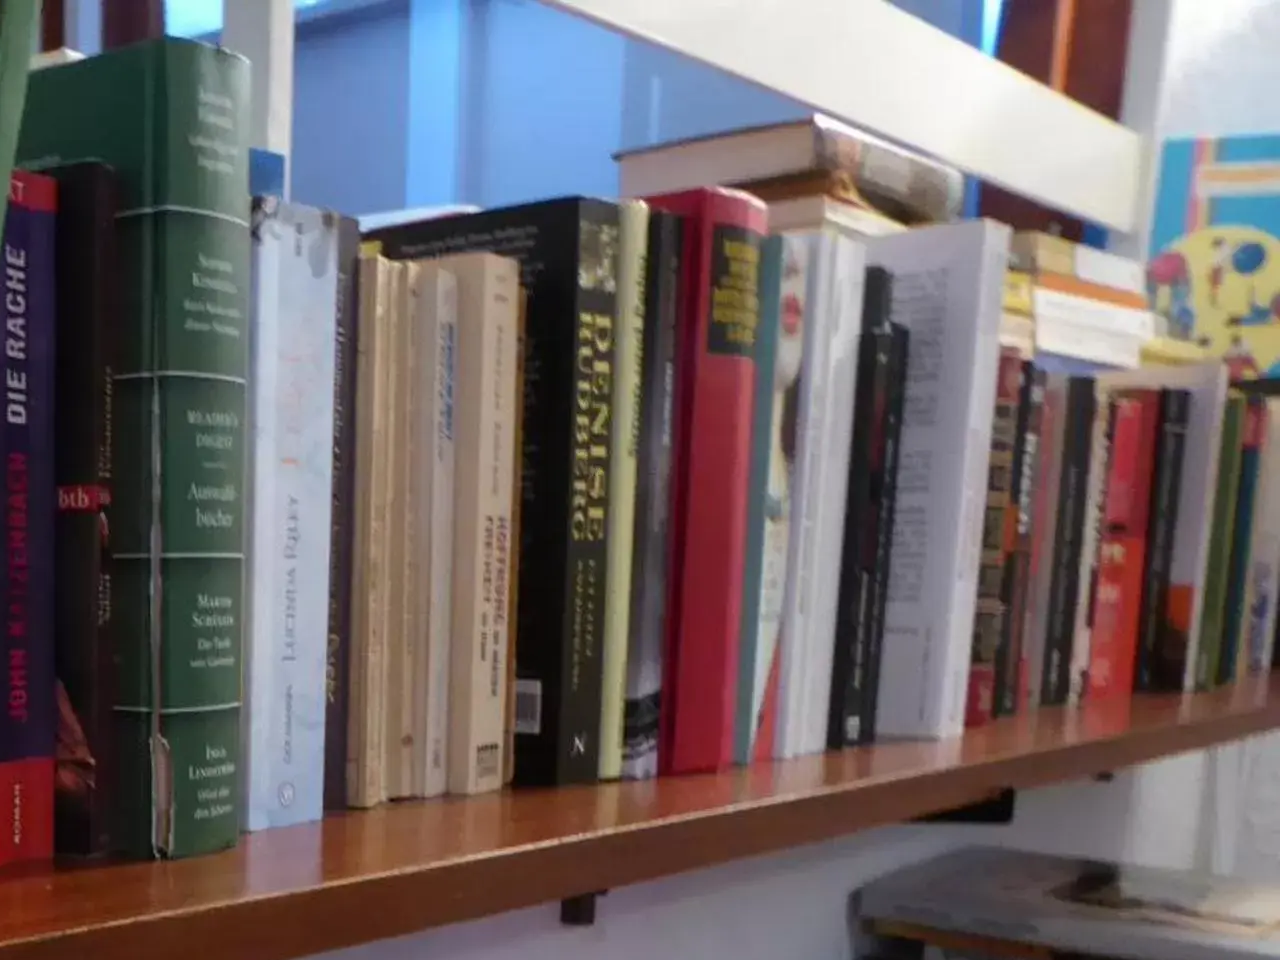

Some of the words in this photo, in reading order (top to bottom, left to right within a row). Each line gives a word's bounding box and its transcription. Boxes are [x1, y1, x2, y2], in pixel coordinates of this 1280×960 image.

[6, 246, 27, 360] RACHE
[6, 368, 27, 426] DIE
[586, 312, 615, 542] DENISE
[8, 652, 28, 723] JOHN
